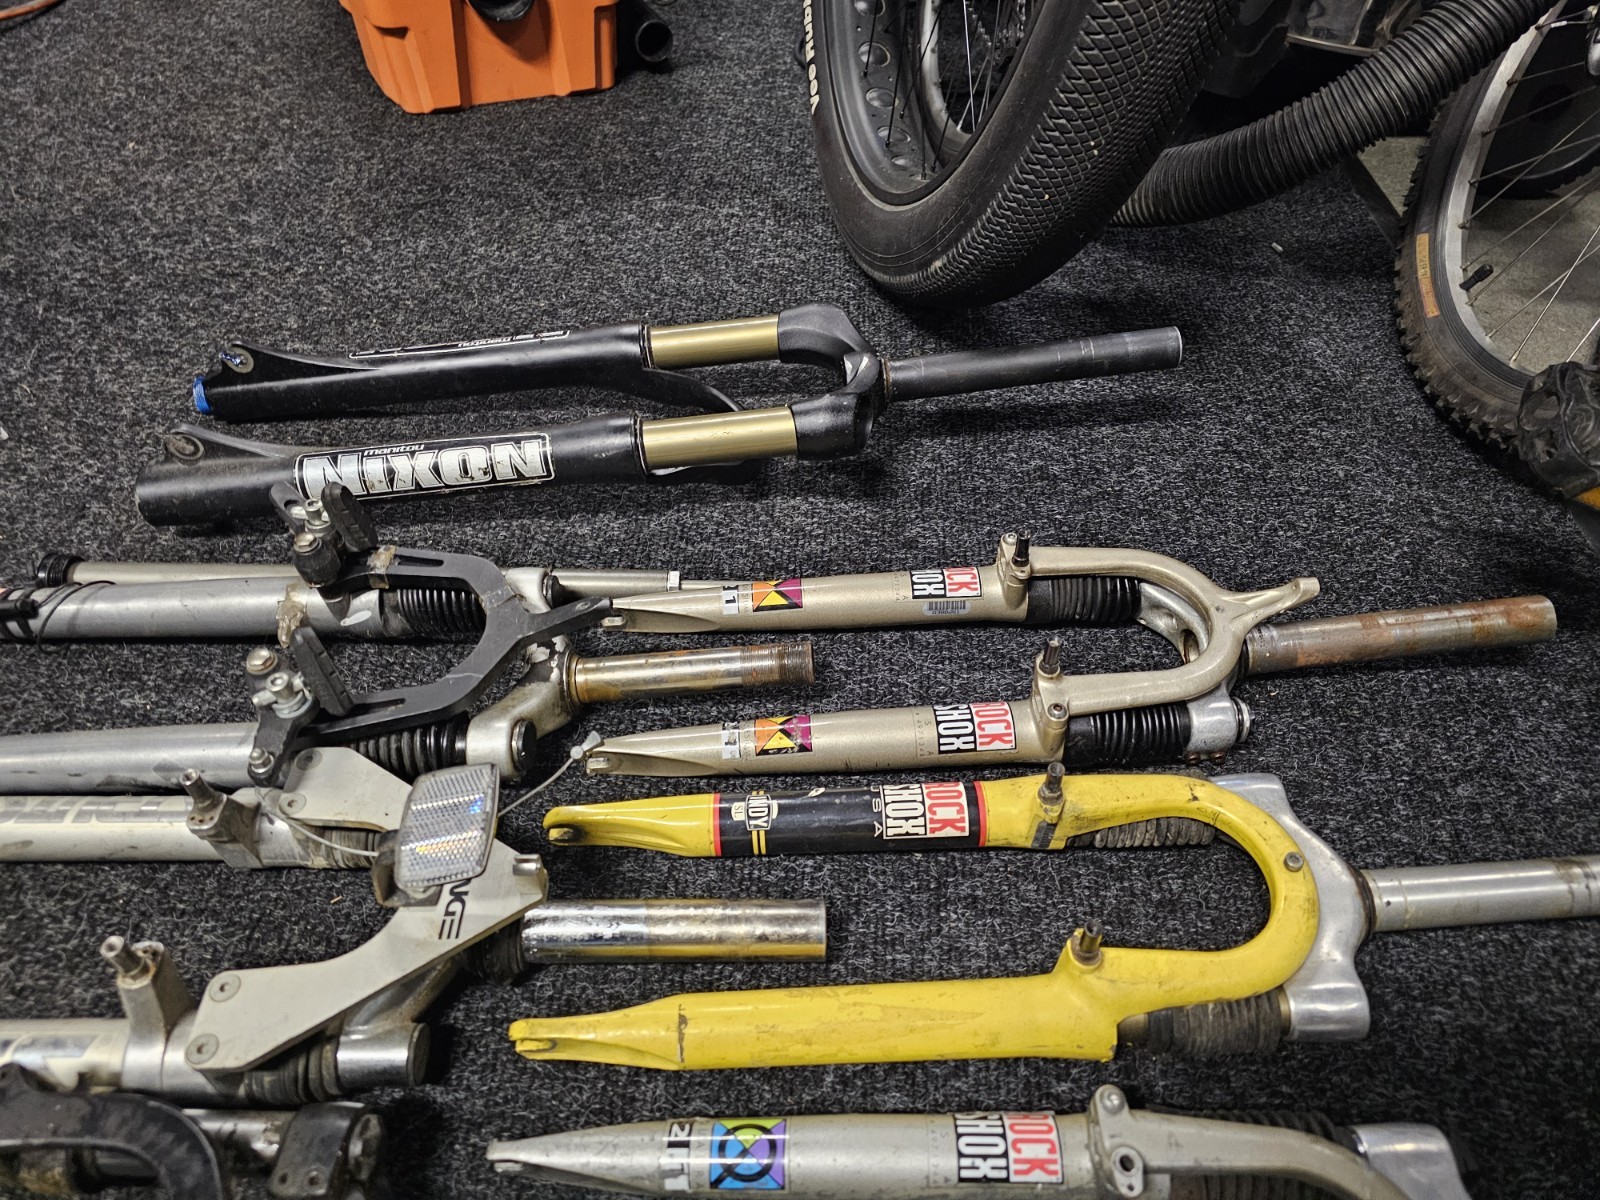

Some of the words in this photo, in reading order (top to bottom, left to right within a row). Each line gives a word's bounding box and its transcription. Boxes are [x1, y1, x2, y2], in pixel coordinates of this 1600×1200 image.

[302, 438, 549, 500] NIXON
[364, 444, 425, 456] manitou
[944, 567, 979, 592] OCK
[748, 796, 769, 828] INDY
[883, 783, 926, 837] SHOX
[924, 782, 966, 834] ROCK
[954, 1113, 1008, 1179] SHOX
[1007, 1113, 1059, 1176] ROCK
